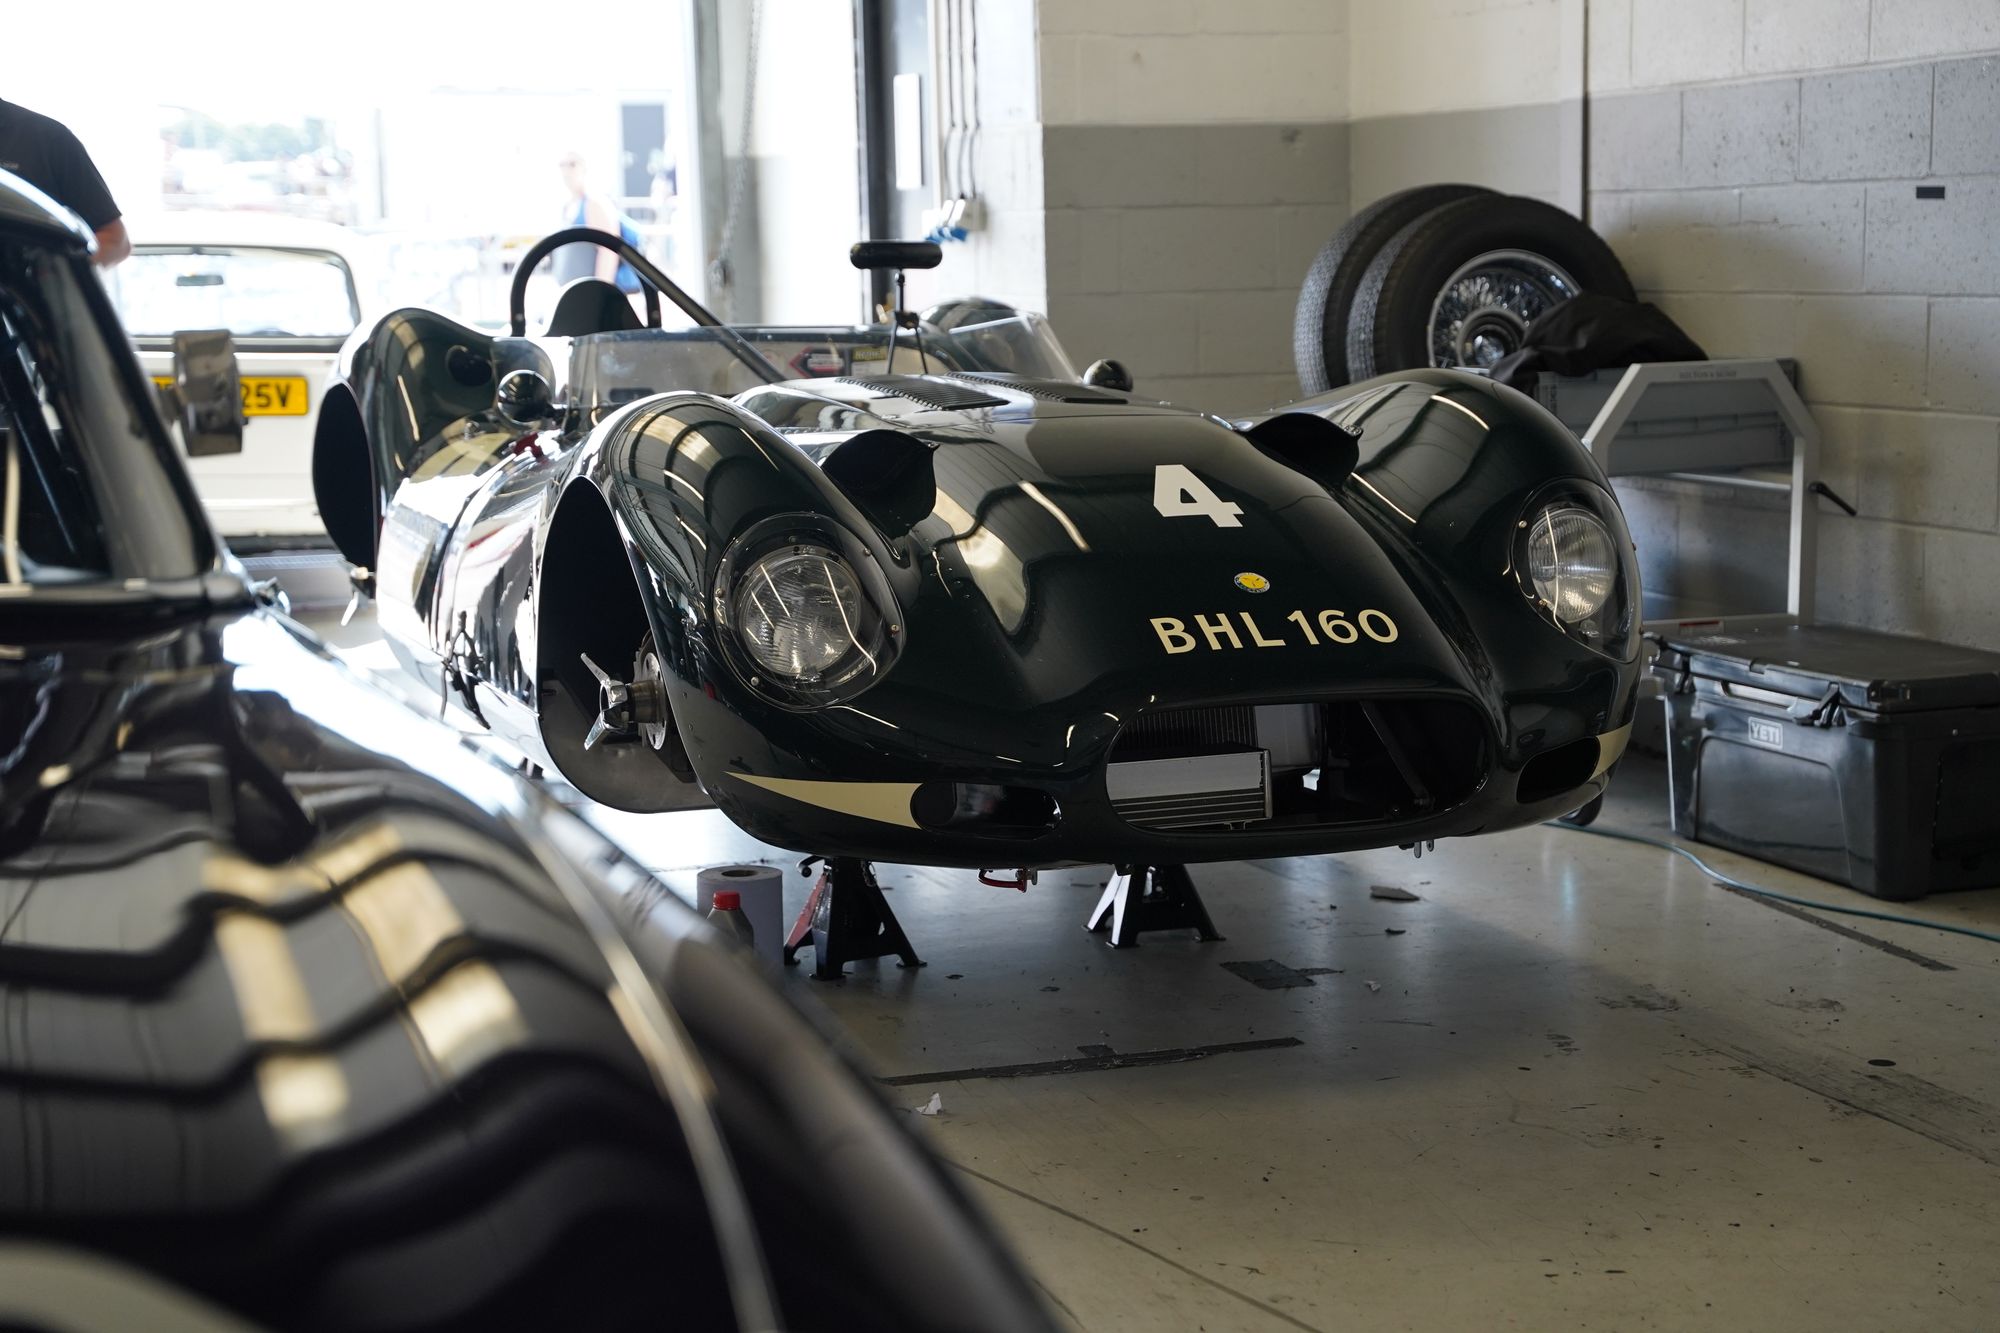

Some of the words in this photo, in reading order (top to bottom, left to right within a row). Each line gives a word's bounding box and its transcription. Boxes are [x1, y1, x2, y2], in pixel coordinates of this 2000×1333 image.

[1153, 464, 1244, 528] 4
[1149, 611, 1286, 655] BHL
[1287, 608, 1399, 646] 160
[1751, 721, 1780, 743] YETI
